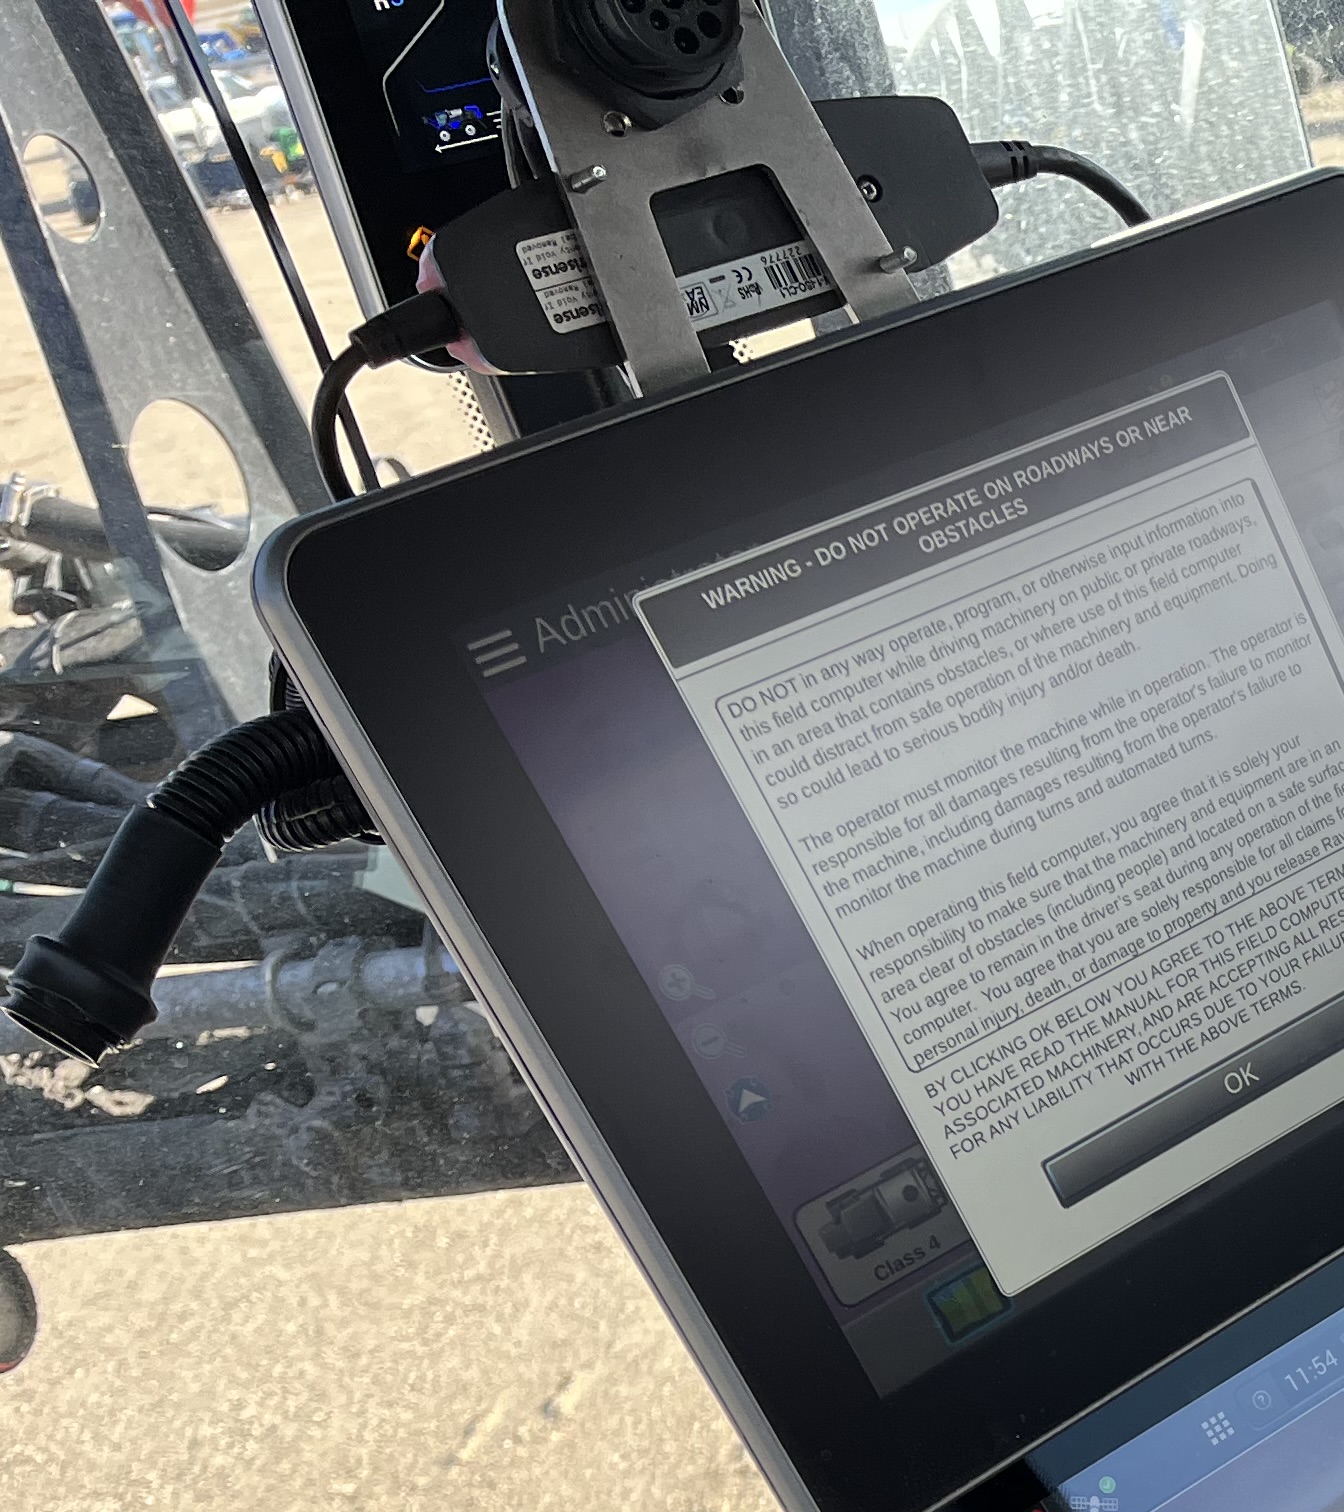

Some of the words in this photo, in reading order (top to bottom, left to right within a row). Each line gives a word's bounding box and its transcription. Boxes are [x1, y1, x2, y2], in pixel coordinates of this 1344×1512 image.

[761, 246, 802, 265] 227776
[700, 558, 802, 609] WARNING
[813, 540, 846, 566] DO
[846, 522, 889, 553] NOT
[892, 487, 983, 535] OPERATE
[982, 475, 1013, 499] ON
[1012, 436, 1114, 489] ROADWAYS
[1115, 425, 1144, 447] OR
[1142, 405, 1193, 437] NEAR
[918, 497, 1028, 553] OBSTACLES
[726, 695, 758, 719] DO
[757, 676, 798, 706] NOT
[798, 672, 819, 689] in
[819, 658, 850, 681] any
[850, 643, 885, 667] way
[887, 618, 953, 652] operate,
[952, 589, 1022, 628] program,
[1020, 580, 1037, 596] or
[1038, 551, 1107, 589] otherwise
[1106, 533, 1146, 560] input
[1142, 504, 1219, 545] information
[1218, 493, 1245, 512] into
[738, 719, 772, 742] this
[771, 700, 809, 728] field
[809, 670, 884, 713] computer
[884, 653, 927, 680] while
[928, 631, 981, 662] driving
[979, 598, 1056, 640] machinery
[1057, 589, 1079, 606] on
[1078, 570, 1122, 601] public
[1123, 562, 1138, 579] or
[1139, 543, 1186, 575] private
[1186, 515, 1257, 551] roadways,
[922, 1074, 947, 1099] BY
[949, 1034, 1028, 1085] CLICKING
[1028, 1018, 1055, 1043] OK
[1053, 987, 1112, 1030] BELOW
[1111, 969, 1148, 997] YOU
[1150, 940, 1204, 980] AGREE
[1200, 929, 1225, 949] TO
[1223, 911, 1258, 937] THE
[1258, 884, 1308, 922] ABOVE
[943, 1074, 1045, 1140] ASSOCIATED
[1044, 1021, 1142, 1083] MACHINERY,
[1141, 1003, 1174, 1032] AND
[1175, 984, 1209, 1013] ARE
[1208, 939, 1291, 996] ACCEPTING
[1292, 926, 1320, 950] ALL
[1122, 1054, 1166, 1086] WITH
[1163, 1036, 1199, 1062] THE
[1199, 1007, 1251, 1047] ABOVE
[1248, 979, 1306, 1016] TERMS.
[1223, 1061, 1260, 1094] OK
[874, 1247, 926, 1281] Class
[929, 1235, 941, 1250] 4
[1285, 1349, 1338, 1391] 11:54
